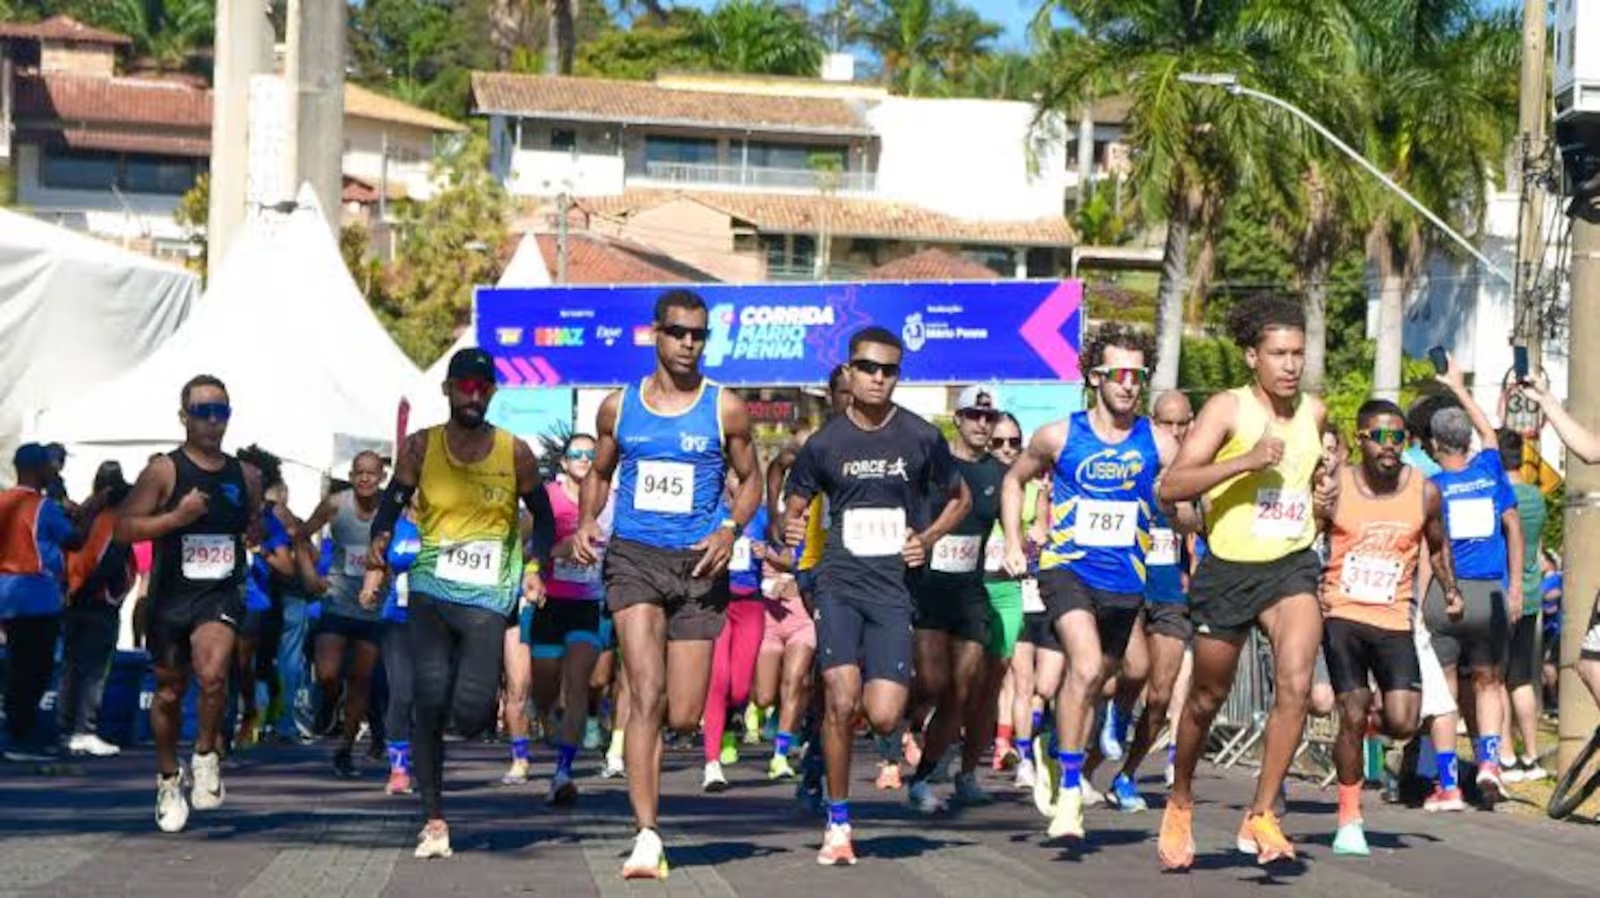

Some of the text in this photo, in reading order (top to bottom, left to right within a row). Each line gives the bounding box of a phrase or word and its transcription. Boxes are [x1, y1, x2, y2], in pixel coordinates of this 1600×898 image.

[740, 306, 834, 325] CORRIDA
[732, 340, 804, 359] PENNA
[843, 460, 886, 476] FORCE
[644, 474, 683, 496] 945
[1258, 501, 1305, 521] 2842
[1089, 512, 1125, 531] 787
[184, 546, 233, 564] 2926
[446, 547, 491, 570] 1991
[1348, 566, 1397, 590] 3127
